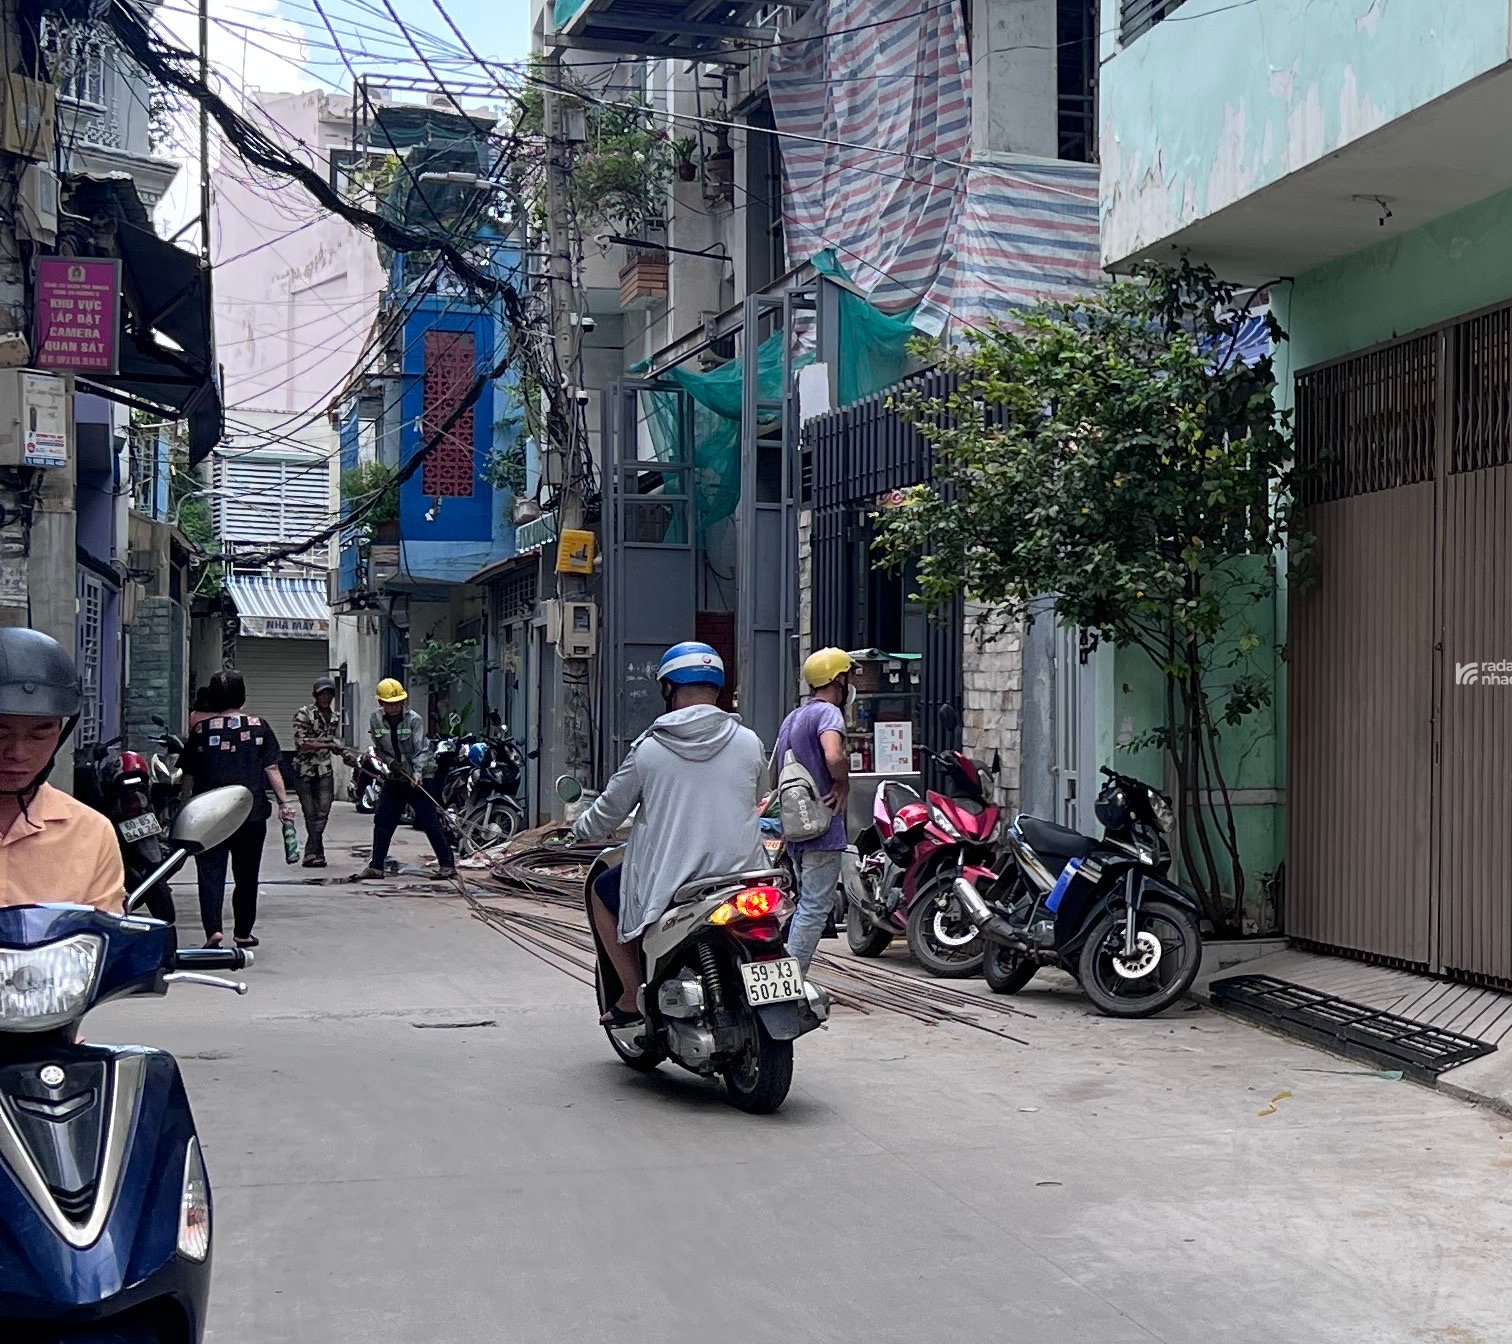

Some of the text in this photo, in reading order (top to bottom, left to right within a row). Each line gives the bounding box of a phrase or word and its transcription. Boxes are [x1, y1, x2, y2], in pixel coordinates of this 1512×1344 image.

[49, 327, 101, 338] CAMERA
[44, 340, 77, 352] QUAN
[750, 961, 793, 982] 59-X3
[749, 979, 802, 1001] 502.84
